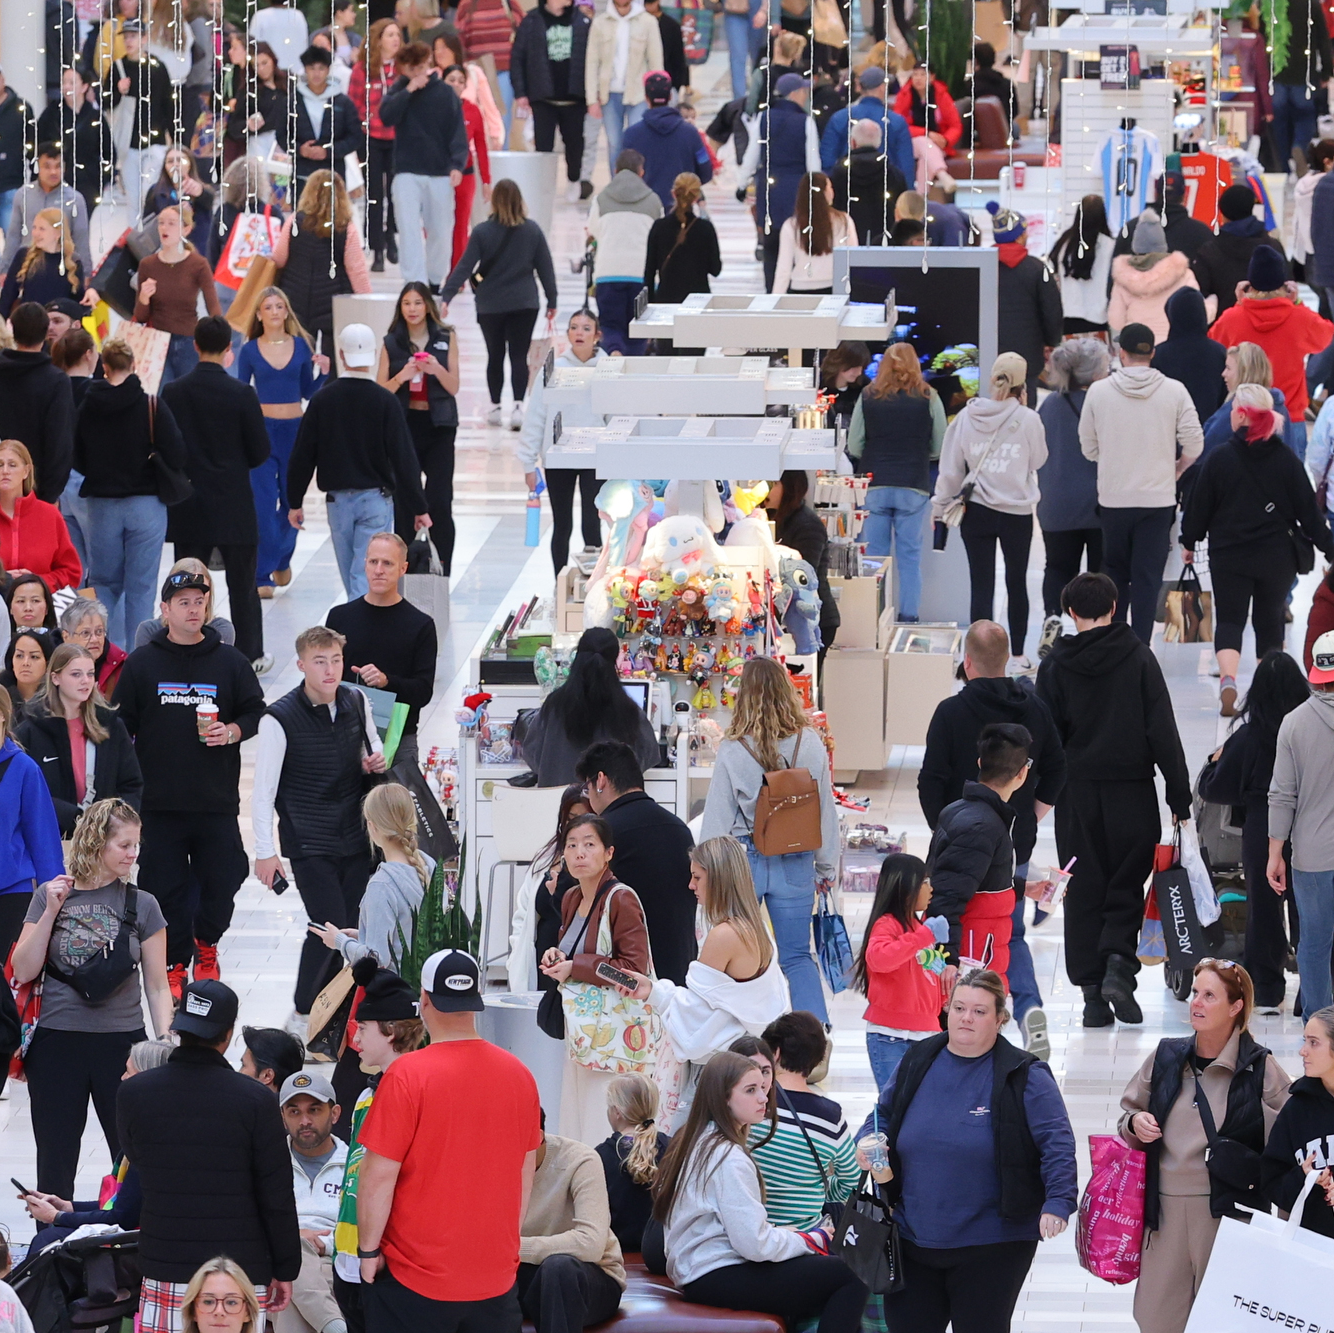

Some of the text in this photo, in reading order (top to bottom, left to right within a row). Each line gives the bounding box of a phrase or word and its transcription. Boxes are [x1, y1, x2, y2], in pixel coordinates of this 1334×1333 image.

[160, 694, 213, 706] patagonia
[1102, 1208, 1140, 1229] holiday
[1233, 1295, 1259, 1316] THE
[1259, 1305, 1306, 1333] SUPER
